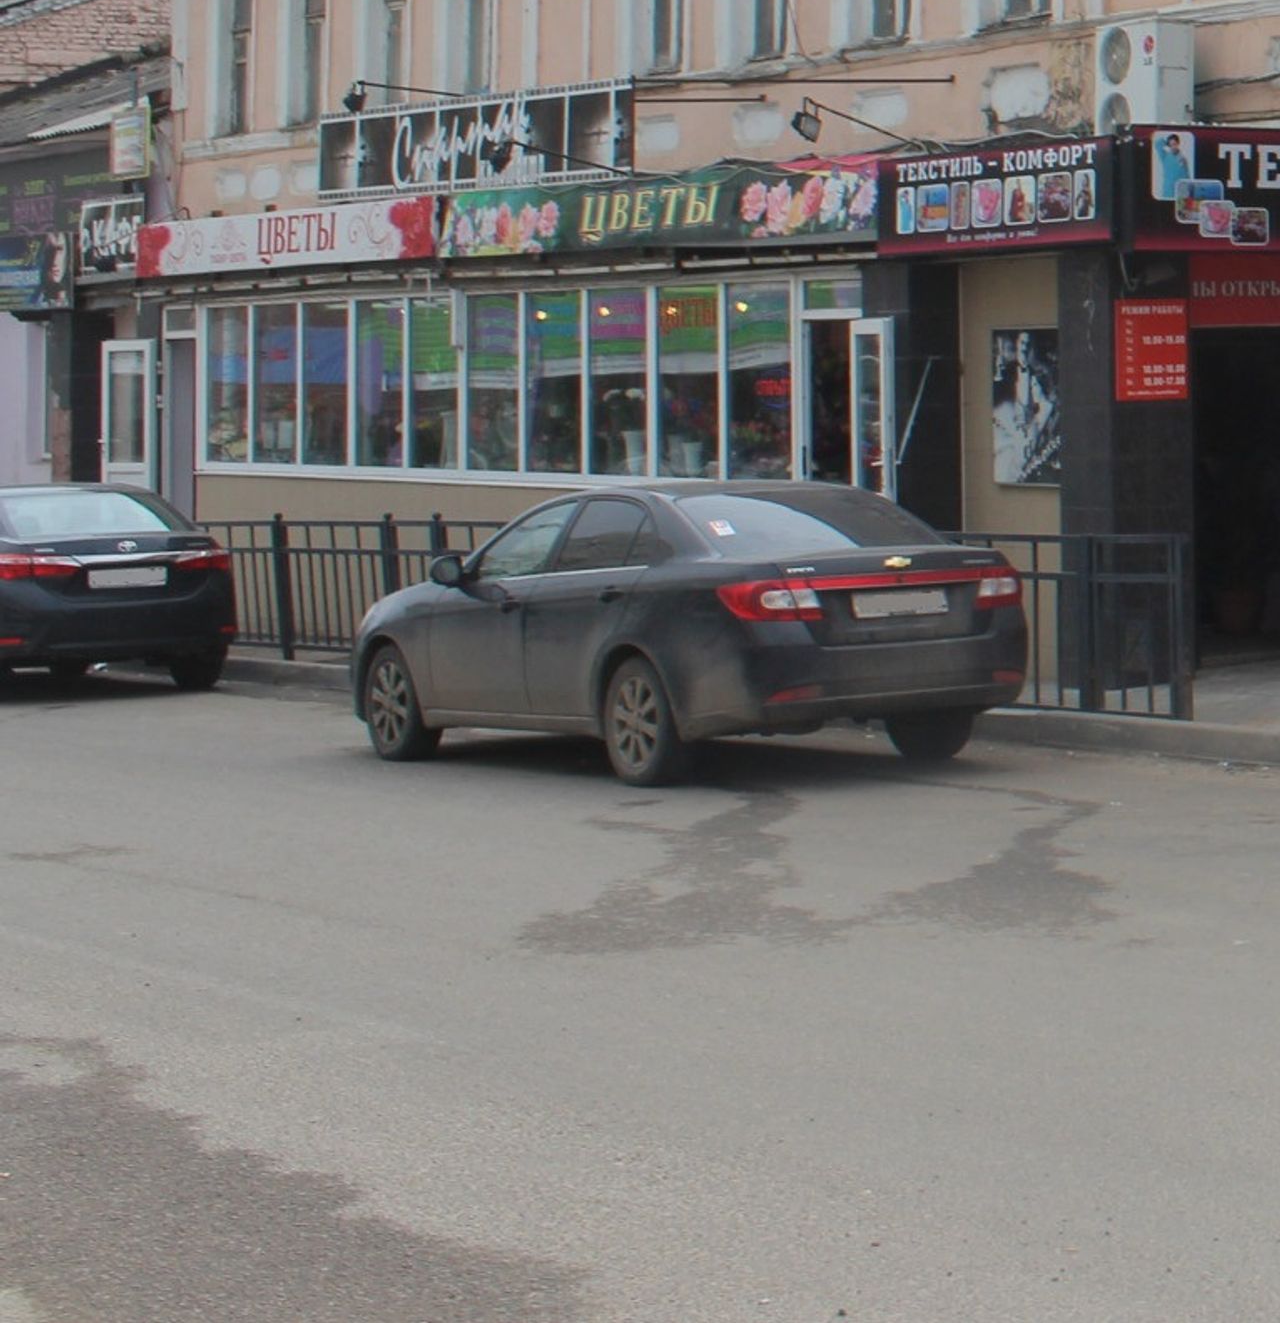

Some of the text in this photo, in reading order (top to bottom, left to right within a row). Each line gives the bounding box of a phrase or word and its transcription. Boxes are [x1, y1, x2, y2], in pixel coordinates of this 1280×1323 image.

[896, 156, 983, 182] ТЕКСТИЛЬ
[1002, 143, 1097, 172] КОМФОРТ
[257, 212, 337, 264] ЦВЕТЫ
[578, 184, 720, 244] ЦВЕТЫ
